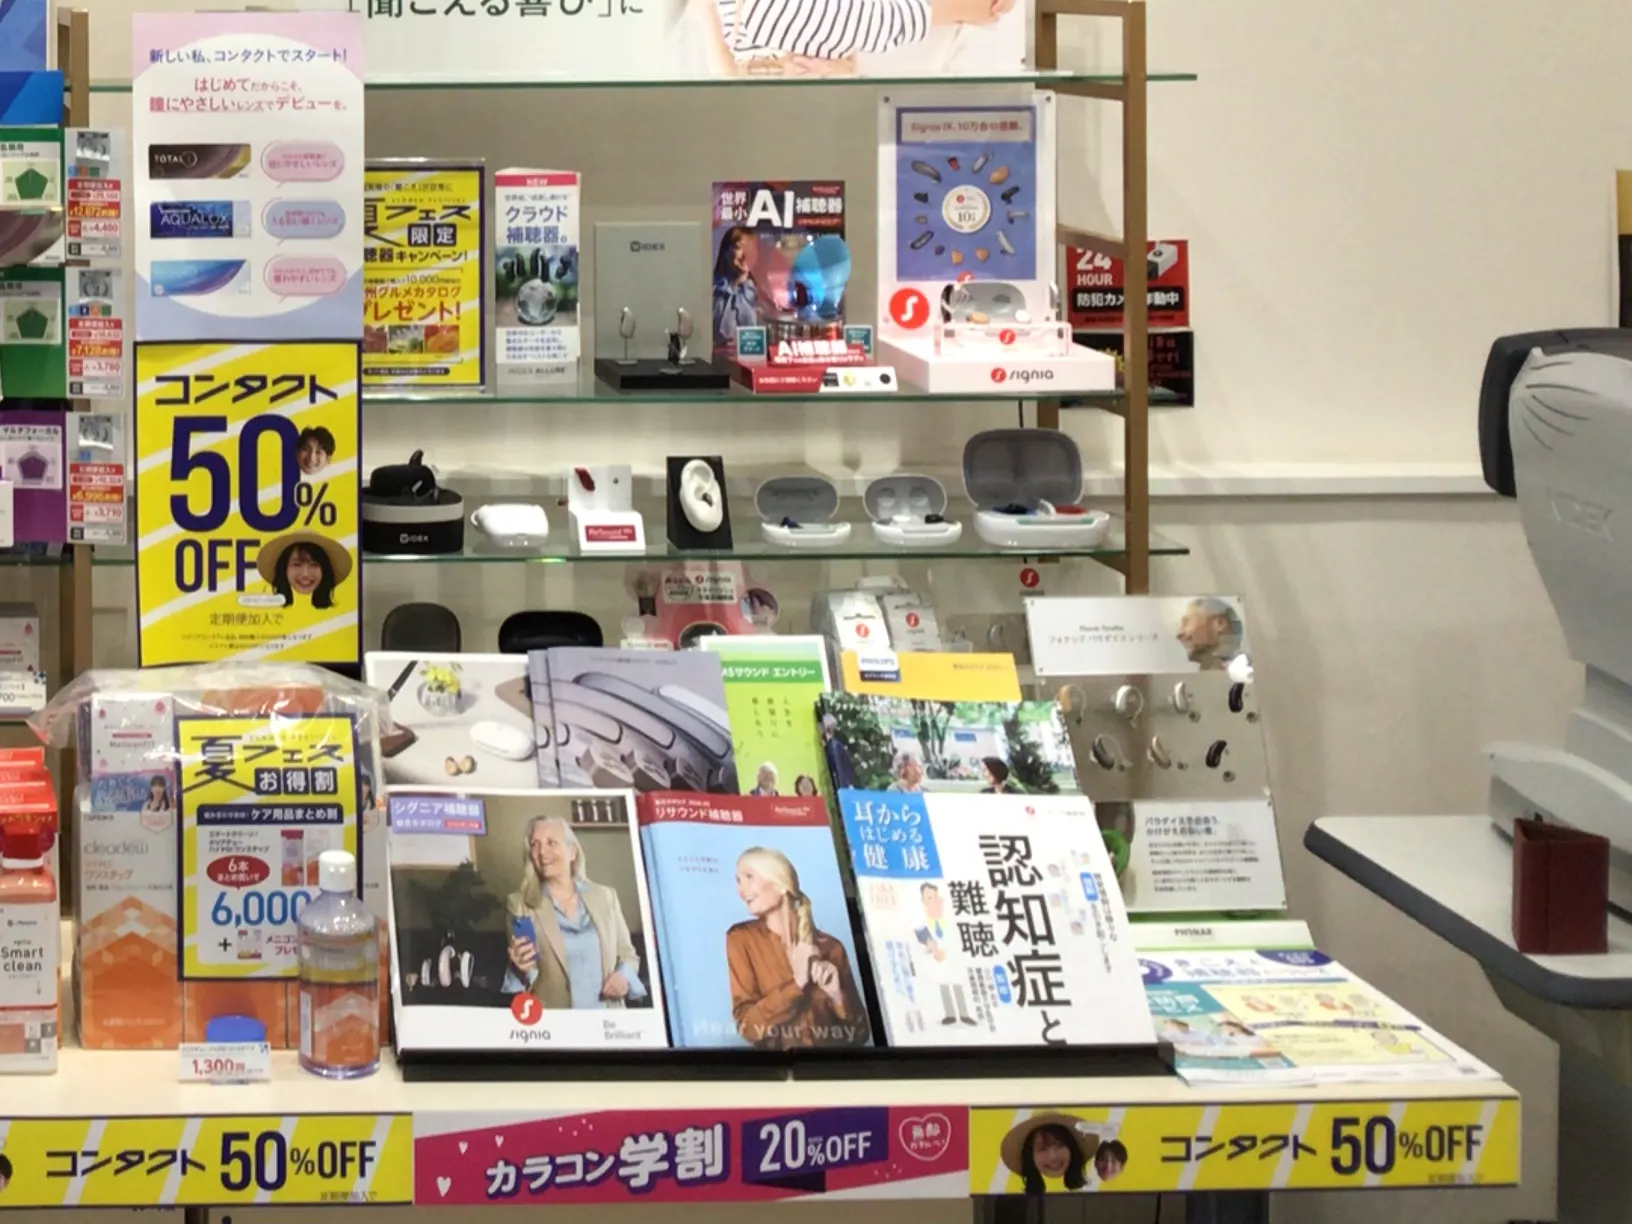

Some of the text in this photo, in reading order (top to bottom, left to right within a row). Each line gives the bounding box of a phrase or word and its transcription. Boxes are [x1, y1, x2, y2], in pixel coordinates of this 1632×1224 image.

[721, 191, 747, 204] 世界
[796, 197, 843, 214] 補聴器
[505, 205, 569, 224] クラウド
[746, 189, 795, 228] AI
[409, 224, 457, 246] 限定
[1077, 273, 1113, 286] HOUR
[1009, 369, 1054, 381] signia
[155, 375, 338, 405] コンタクト
[174, 538, 260, 593] OFF
[773, 666, 816, 677] エントリー
[183, 736, 346, 794] 夏フェス
[258, 771, 336, 792] お得割
[251, 807, 338, 821] ケア用品まとめ割
[394, 800, 481, 817] シグニア補聴器
[655, 807, 744, 823] リサウンド補聴器
[854, 801, 921, 825] 耳から
[860, 826, 923, 844] はじめる
[228, 857, 249, 872] 6本
[863, 845, 930, 872] 健康
[211, 890, 312, 928] 6,000
[948, 881, 999, 958] 難聴
[978, 834, 1071, 1045] 認知症と
[0, 946, 44, 959] Smart
[3, 960, 42, 973] clean
[603, 1019, 616, 1030] Be
[604, 1029, 641, 1041] Brilliant
[753, 1022, 805, 1040] your
[810, 1023, 856, 1044] way
[509, 1028, 551, 1043] signia
[1161, 1134, 1317, 1164] コンタクト
[1331, 1116, 1484, 1176] 50%OFF
[46, 1149, 206, 1178] コンタクト
[219, 1130, 377, 1192] 50%OFF
[485, 1122, 725, 1196] カラコン学割
